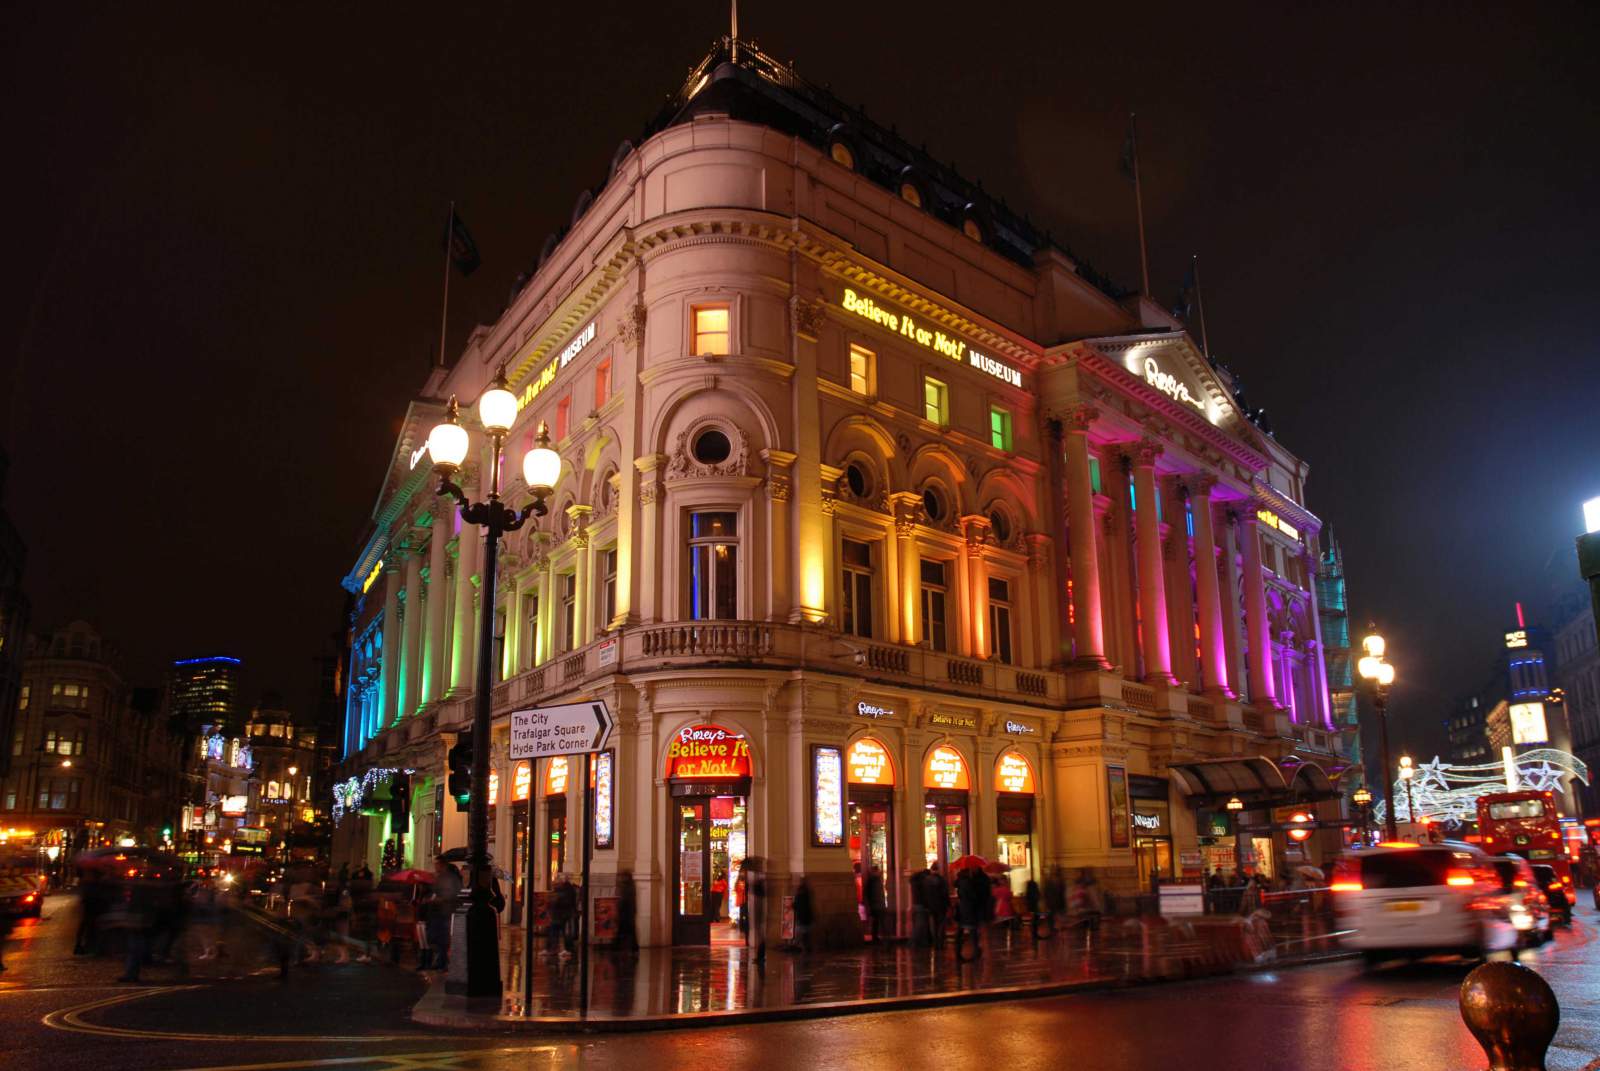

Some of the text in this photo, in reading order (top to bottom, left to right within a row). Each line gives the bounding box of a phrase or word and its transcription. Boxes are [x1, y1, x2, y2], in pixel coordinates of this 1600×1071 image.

[561, 322, 595, 369] MUSEUM
[842, 288, 1022, 388] Believe It or Not! MUSEUM
[514, 713, 549, 726] The City
[933, 713, 952, 724] Believe
[513, 725, 586, 740] Trafalgar Square
[512, 739, 589, 756] Hyde Park Corner
[669, 740, 748, 758] Believe It
[677, 758, 738, 776] or Not!
[1131, 813, 1160, 829] NNABON
